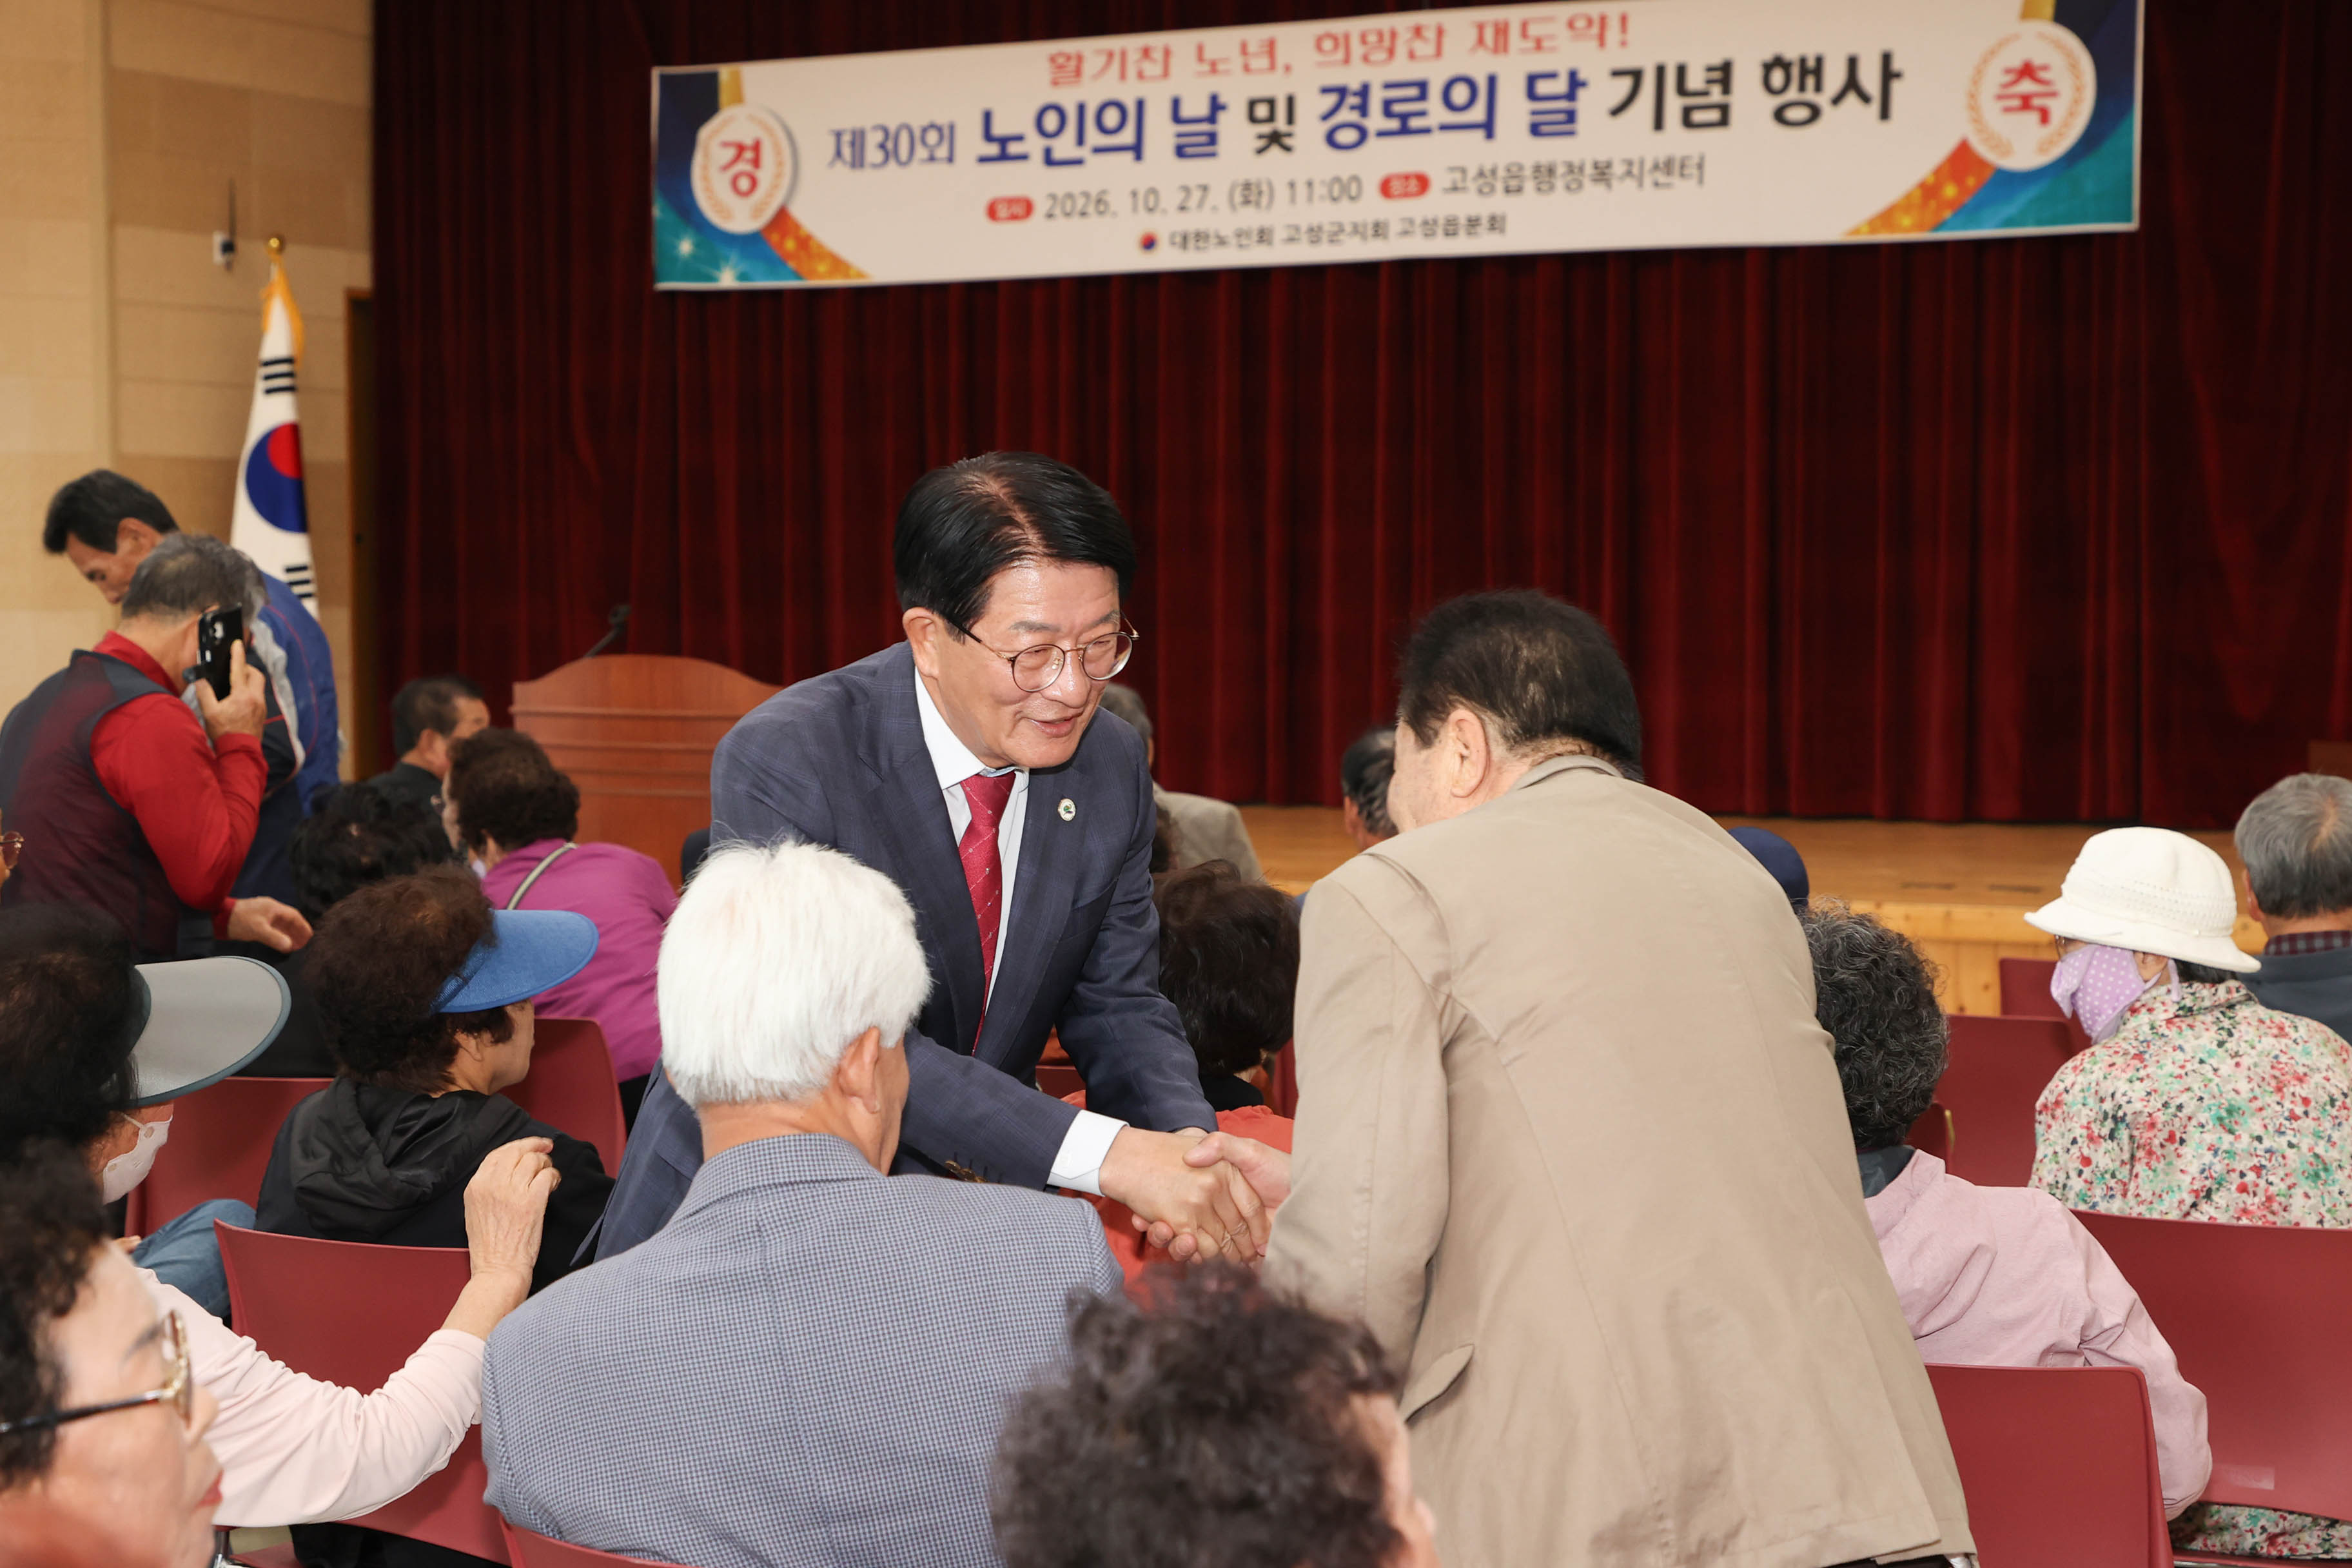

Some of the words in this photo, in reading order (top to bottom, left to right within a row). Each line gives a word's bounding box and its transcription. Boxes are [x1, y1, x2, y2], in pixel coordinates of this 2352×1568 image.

[1193, 37, 1292, 76] 노년,
[1468, 11, 1629, 55] 재도약!
[828, 121, 956, 170] 제30회
[977, 98, 1146, 167] 노인의
[1170, 93, 1228, 160] 날
[1246, 93, 1296, 155] 및
[1319, 74, 1498, 151] 경로의
[1525, 69, 1588, 137] 달
[1609, 59, 1734, 132] 기념
[1761, 50, 1904, 129] 행사
[1993, 59, 2061, 127] 축
[720, 137, 763, 199] 경
[1043, 189, 1117, 220] 2026.
[1129, 186, 1168, 215] 10.
[1177, 183, 1218, 213] 27.
[1227, 177, 1275, 212] (화)
[1286, 173, 1363, 206] 11:00
[1442, 153, 1706, 197] 고성읍행정복지센터
